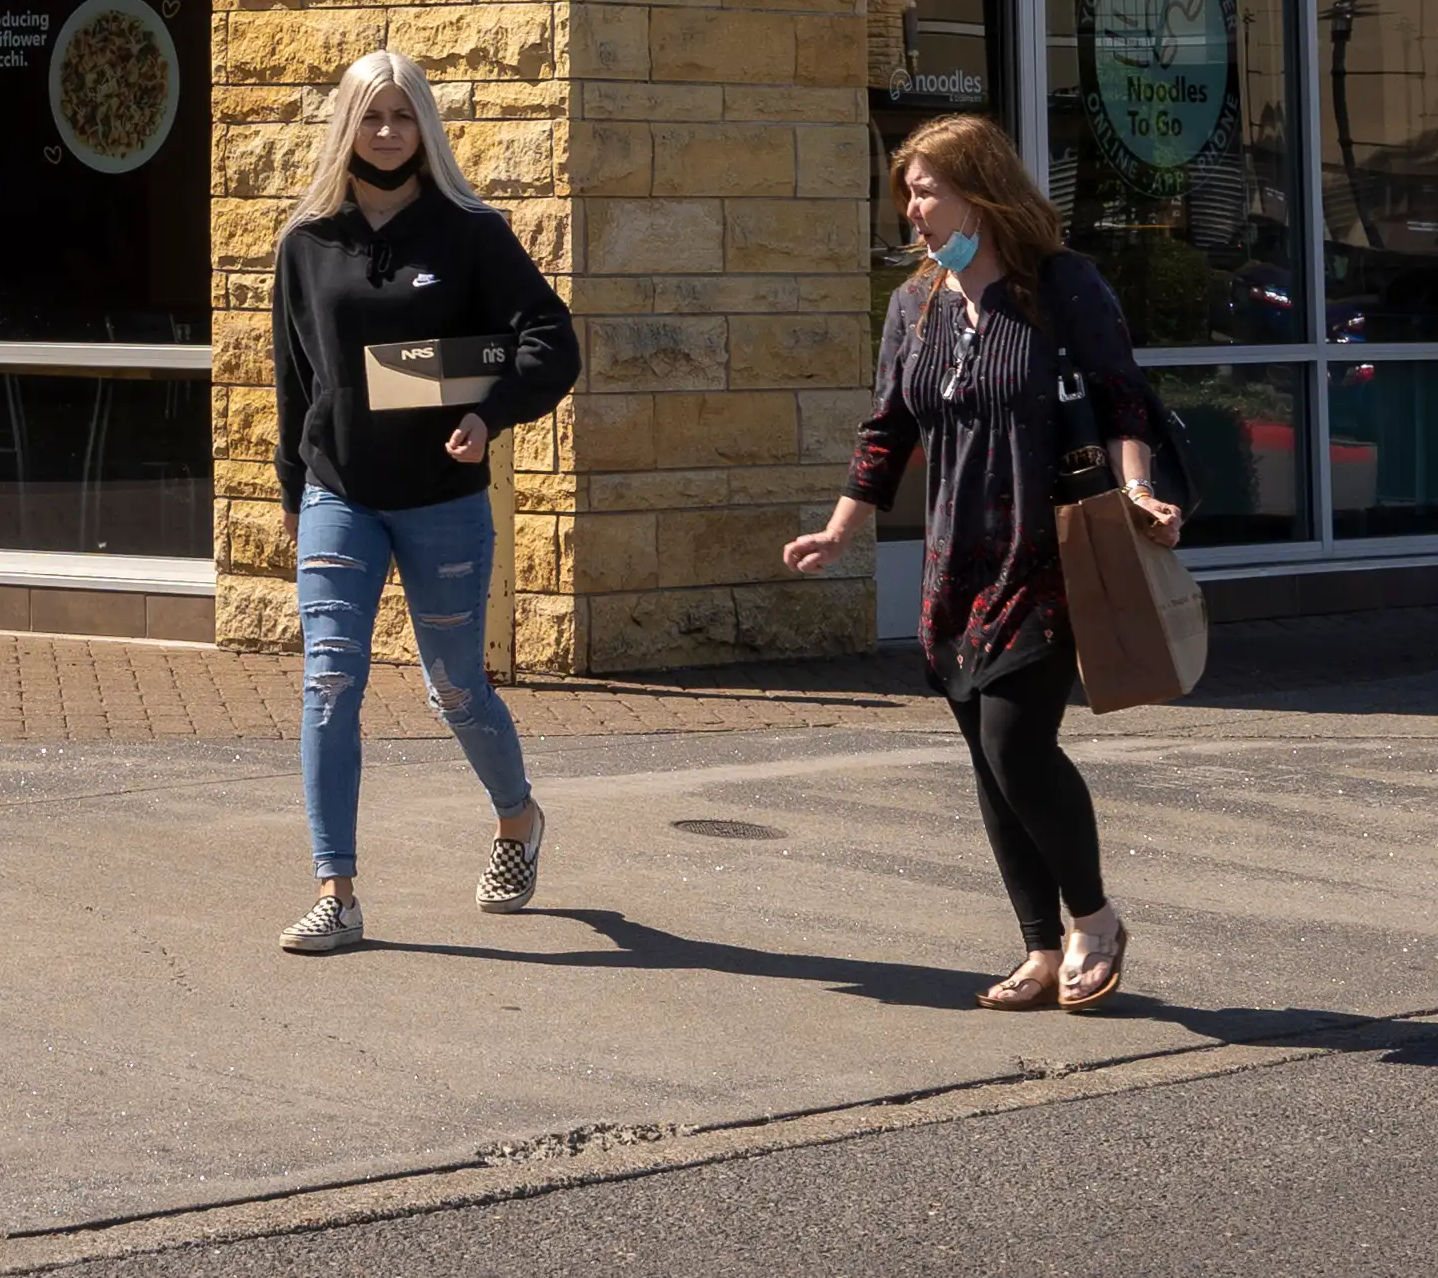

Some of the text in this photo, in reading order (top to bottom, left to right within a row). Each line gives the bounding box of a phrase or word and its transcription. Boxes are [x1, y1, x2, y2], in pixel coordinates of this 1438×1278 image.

[915, 69, 983, 93] noodles
[1127, 76, 1208, 103] Noodles
[1127, 110, 1183, 136] To Go
[1086, 93, 1239, 194] ONLINE APP PHONE
[400, 346, 435, 361] NRS
